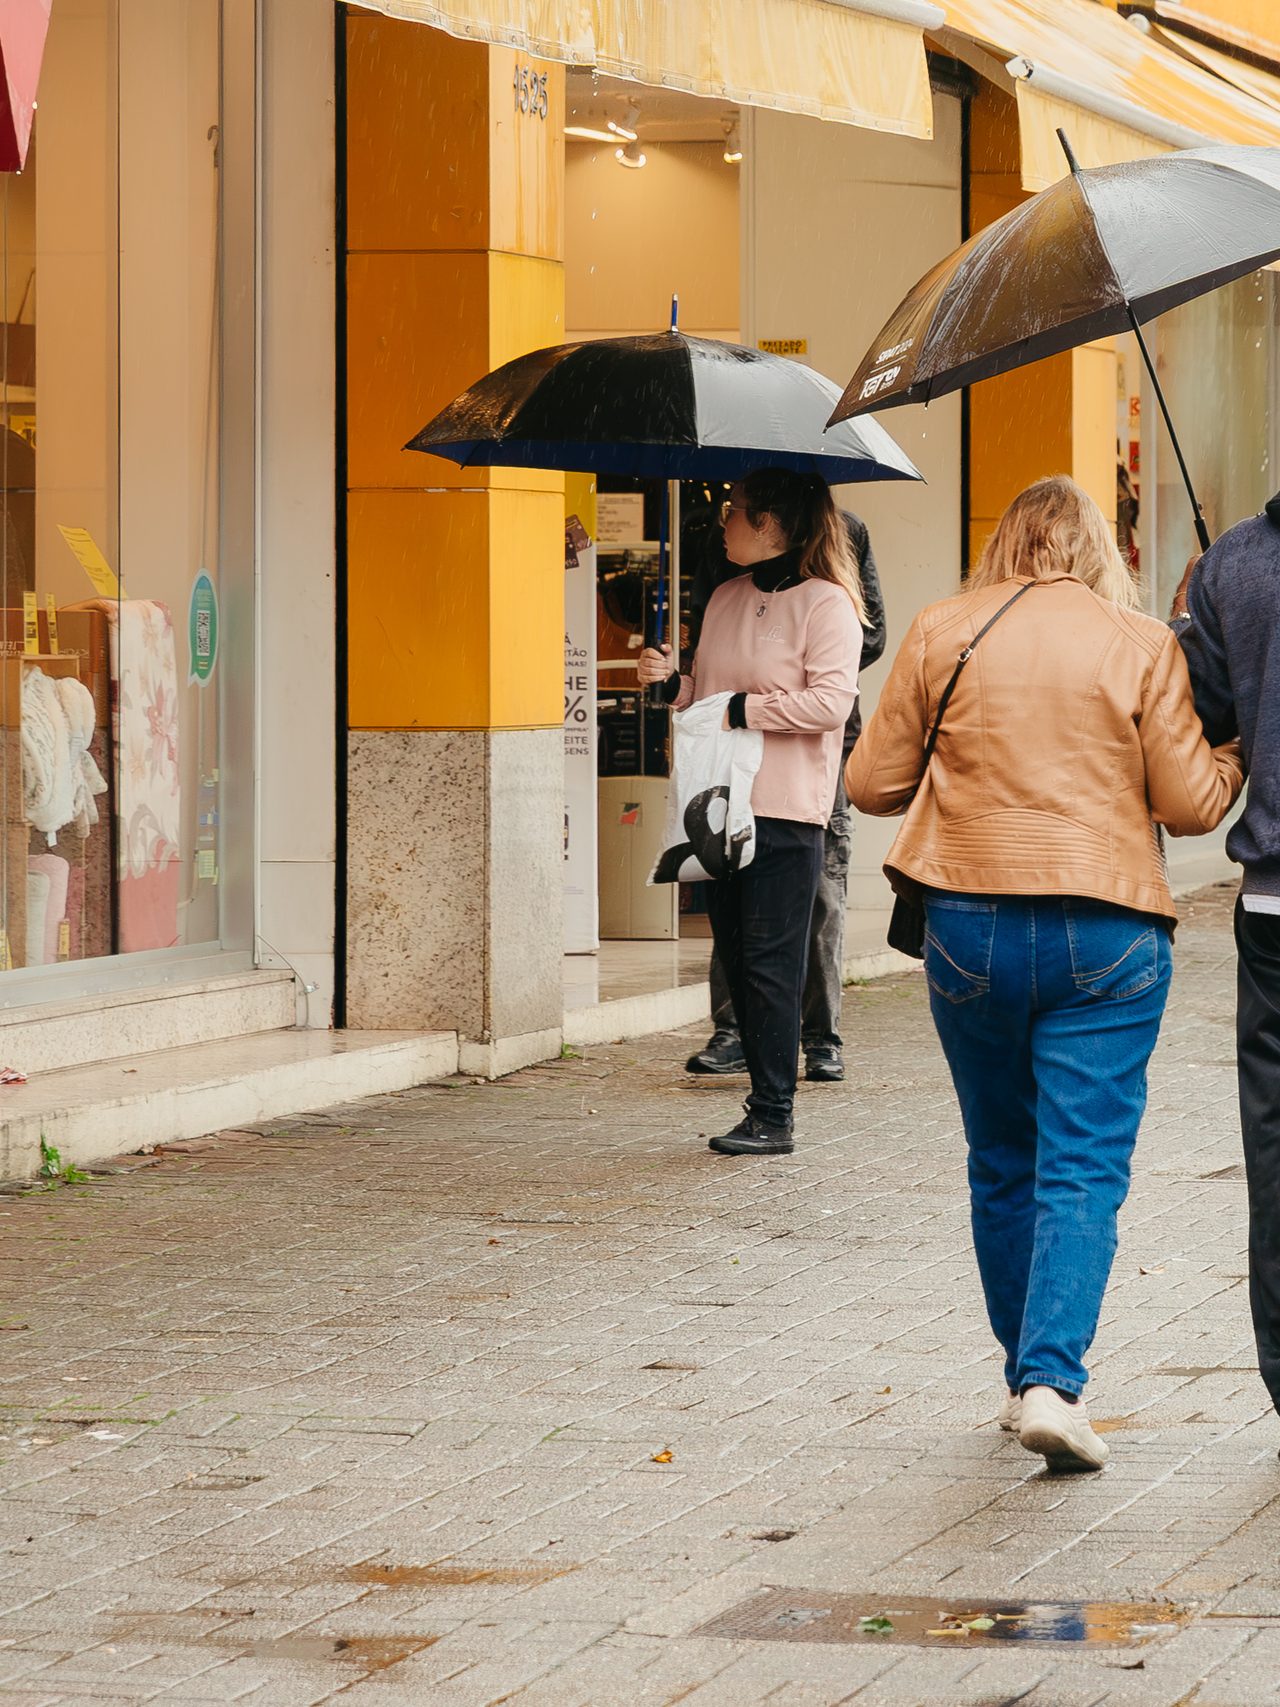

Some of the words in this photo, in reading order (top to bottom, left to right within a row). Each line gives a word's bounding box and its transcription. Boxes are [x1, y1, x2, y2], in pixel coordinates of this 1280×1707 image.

[513, 64, 548, 121] 1525
[762, 340, 803, 348] PREZADO
[564, 647, 587, 657] TÃO
